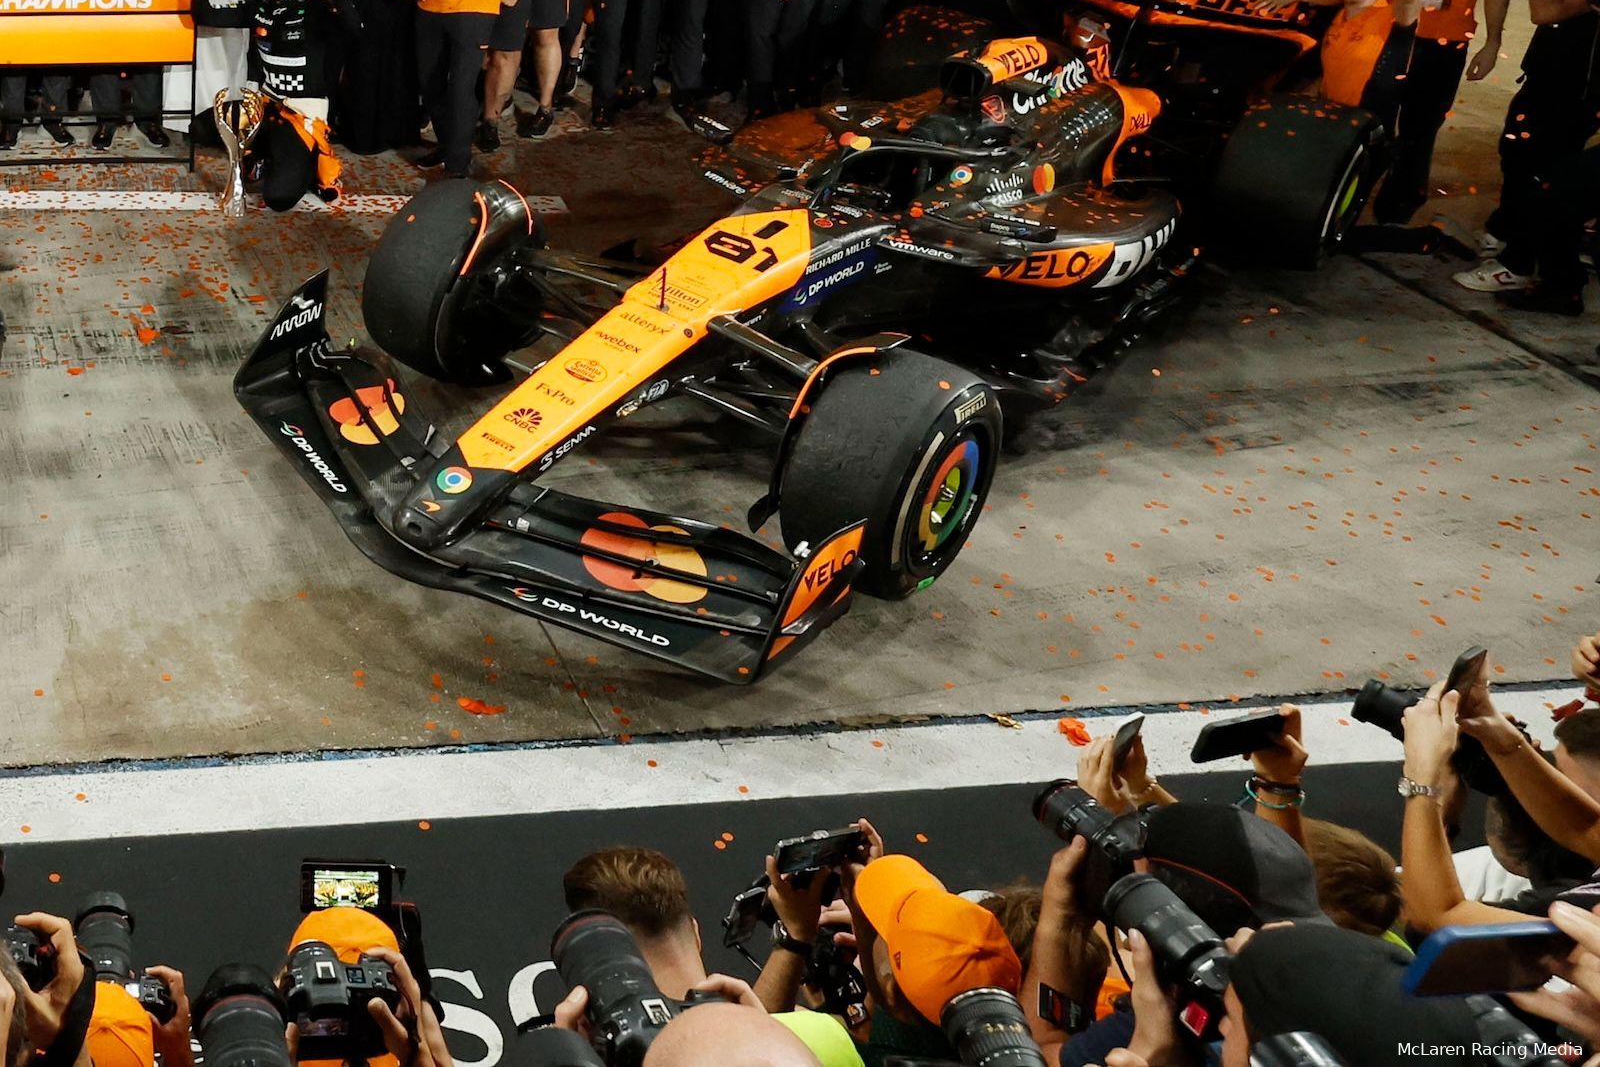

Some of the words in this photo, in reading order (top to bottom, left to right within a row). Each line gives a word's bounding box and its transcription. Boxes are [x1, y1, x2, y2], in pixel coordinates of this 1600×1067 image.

[994, 44, 1040, 75] VELO
[805, 249, 844, 275] RICHARD
[845, 237, 872, 257] MILLE
[889, 240, 954, 260] vmware
[808, 279, 824, 297] DP
[824, 261, 865, 288] WORLD
[619, 311, 672, 337] alteryx
[597, 331, 643, 354] webex
[535, 382, 576, 407] FxPro
[954, 390, 987, 424] PIRELLI
[503, 414, 538, 434] CNBC
[555, 425, 597, 459] SENNA
[291, 435, 307, 456] DP
[305, 451, 348, 494] WORLD
[541, 596, 578, 615] DP
[579, 608, 670, 648] WORLD
